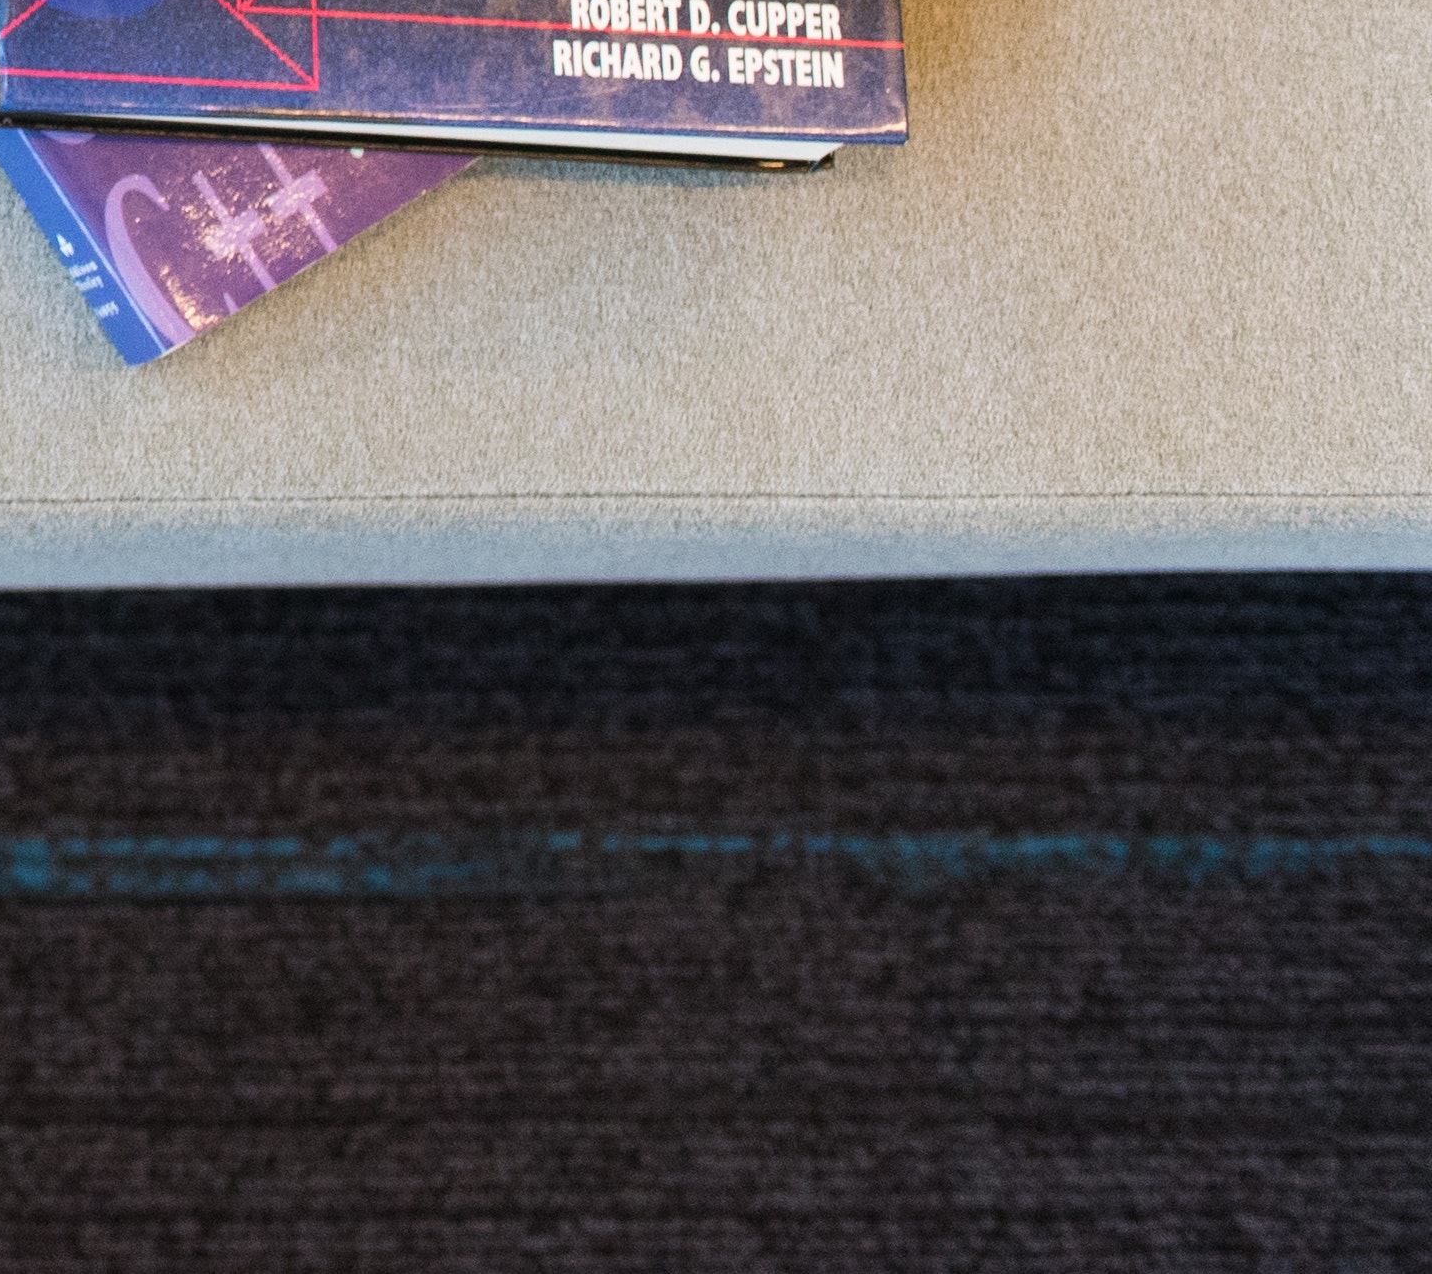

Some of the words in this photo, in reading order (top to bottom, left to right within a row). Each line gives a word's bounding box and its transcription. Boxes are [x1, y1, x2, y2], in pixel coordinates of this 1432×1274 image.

[728, 0, 842, 40] CUPPER
[553, 40, 683, 81] RICHARD
[690, 46, 720, 82] G.
[728, 47, 844, 88] EPSTEIN
